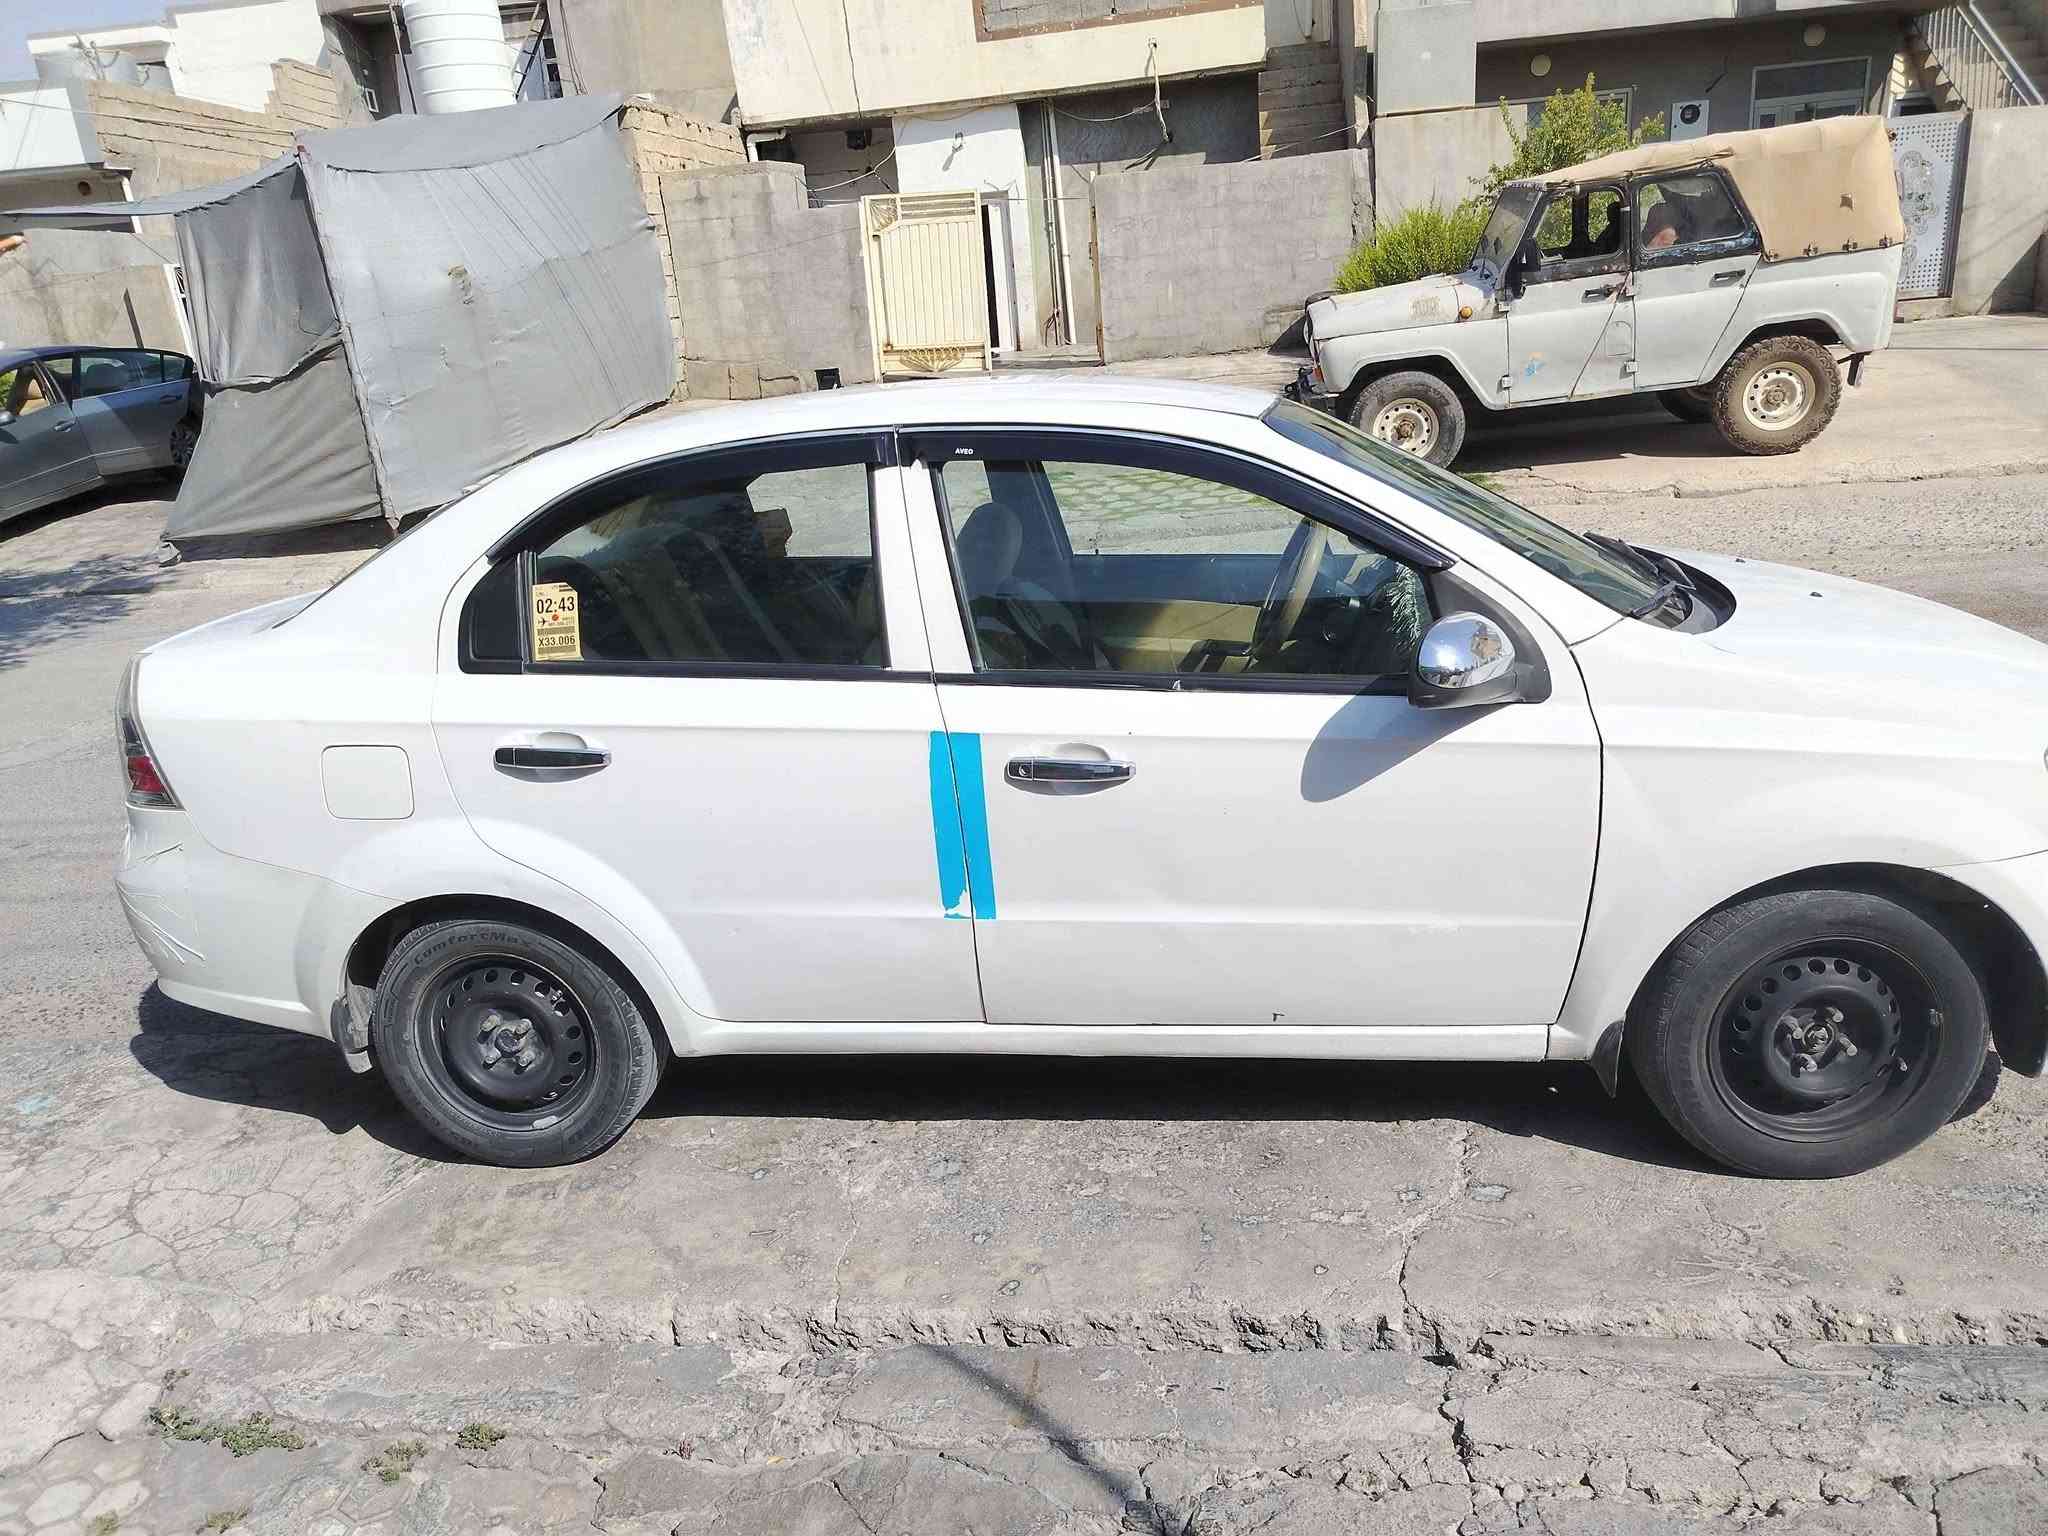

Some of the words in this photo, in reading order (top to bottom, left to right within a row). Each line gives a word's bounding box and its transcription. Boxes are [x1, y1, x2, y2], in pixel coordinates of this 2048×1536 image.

[954, 447, 974, 455] AVEO
[536, 596, 575, 614] 02:43
[538, 635, 576, 647] X33.006
